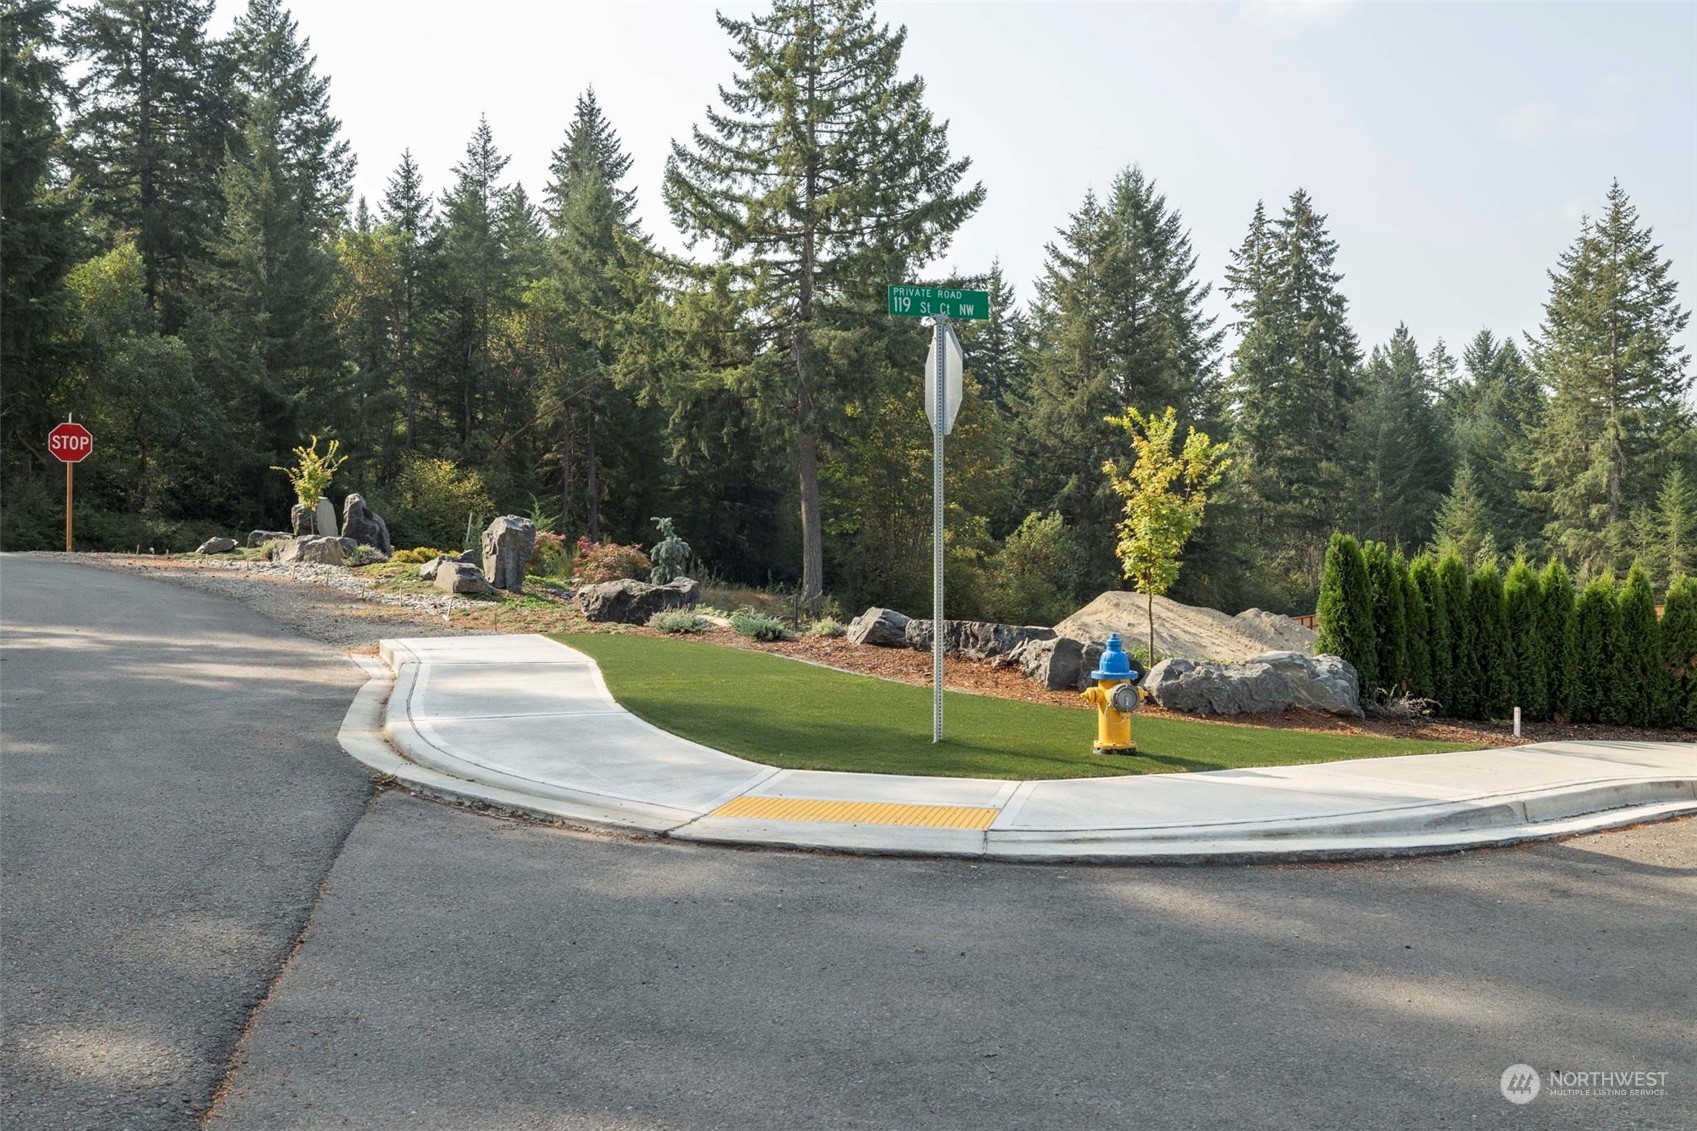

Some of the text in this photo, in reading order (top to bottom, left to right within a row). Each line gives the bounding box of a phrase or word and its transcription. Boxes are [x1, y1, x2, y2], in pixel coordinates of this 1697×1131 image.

[893, 287, 962, 300] PRIVATE ROAD
[893, 296, 974, 316] 119 St Ct NW
[52, 434, 90, 450] STOP
